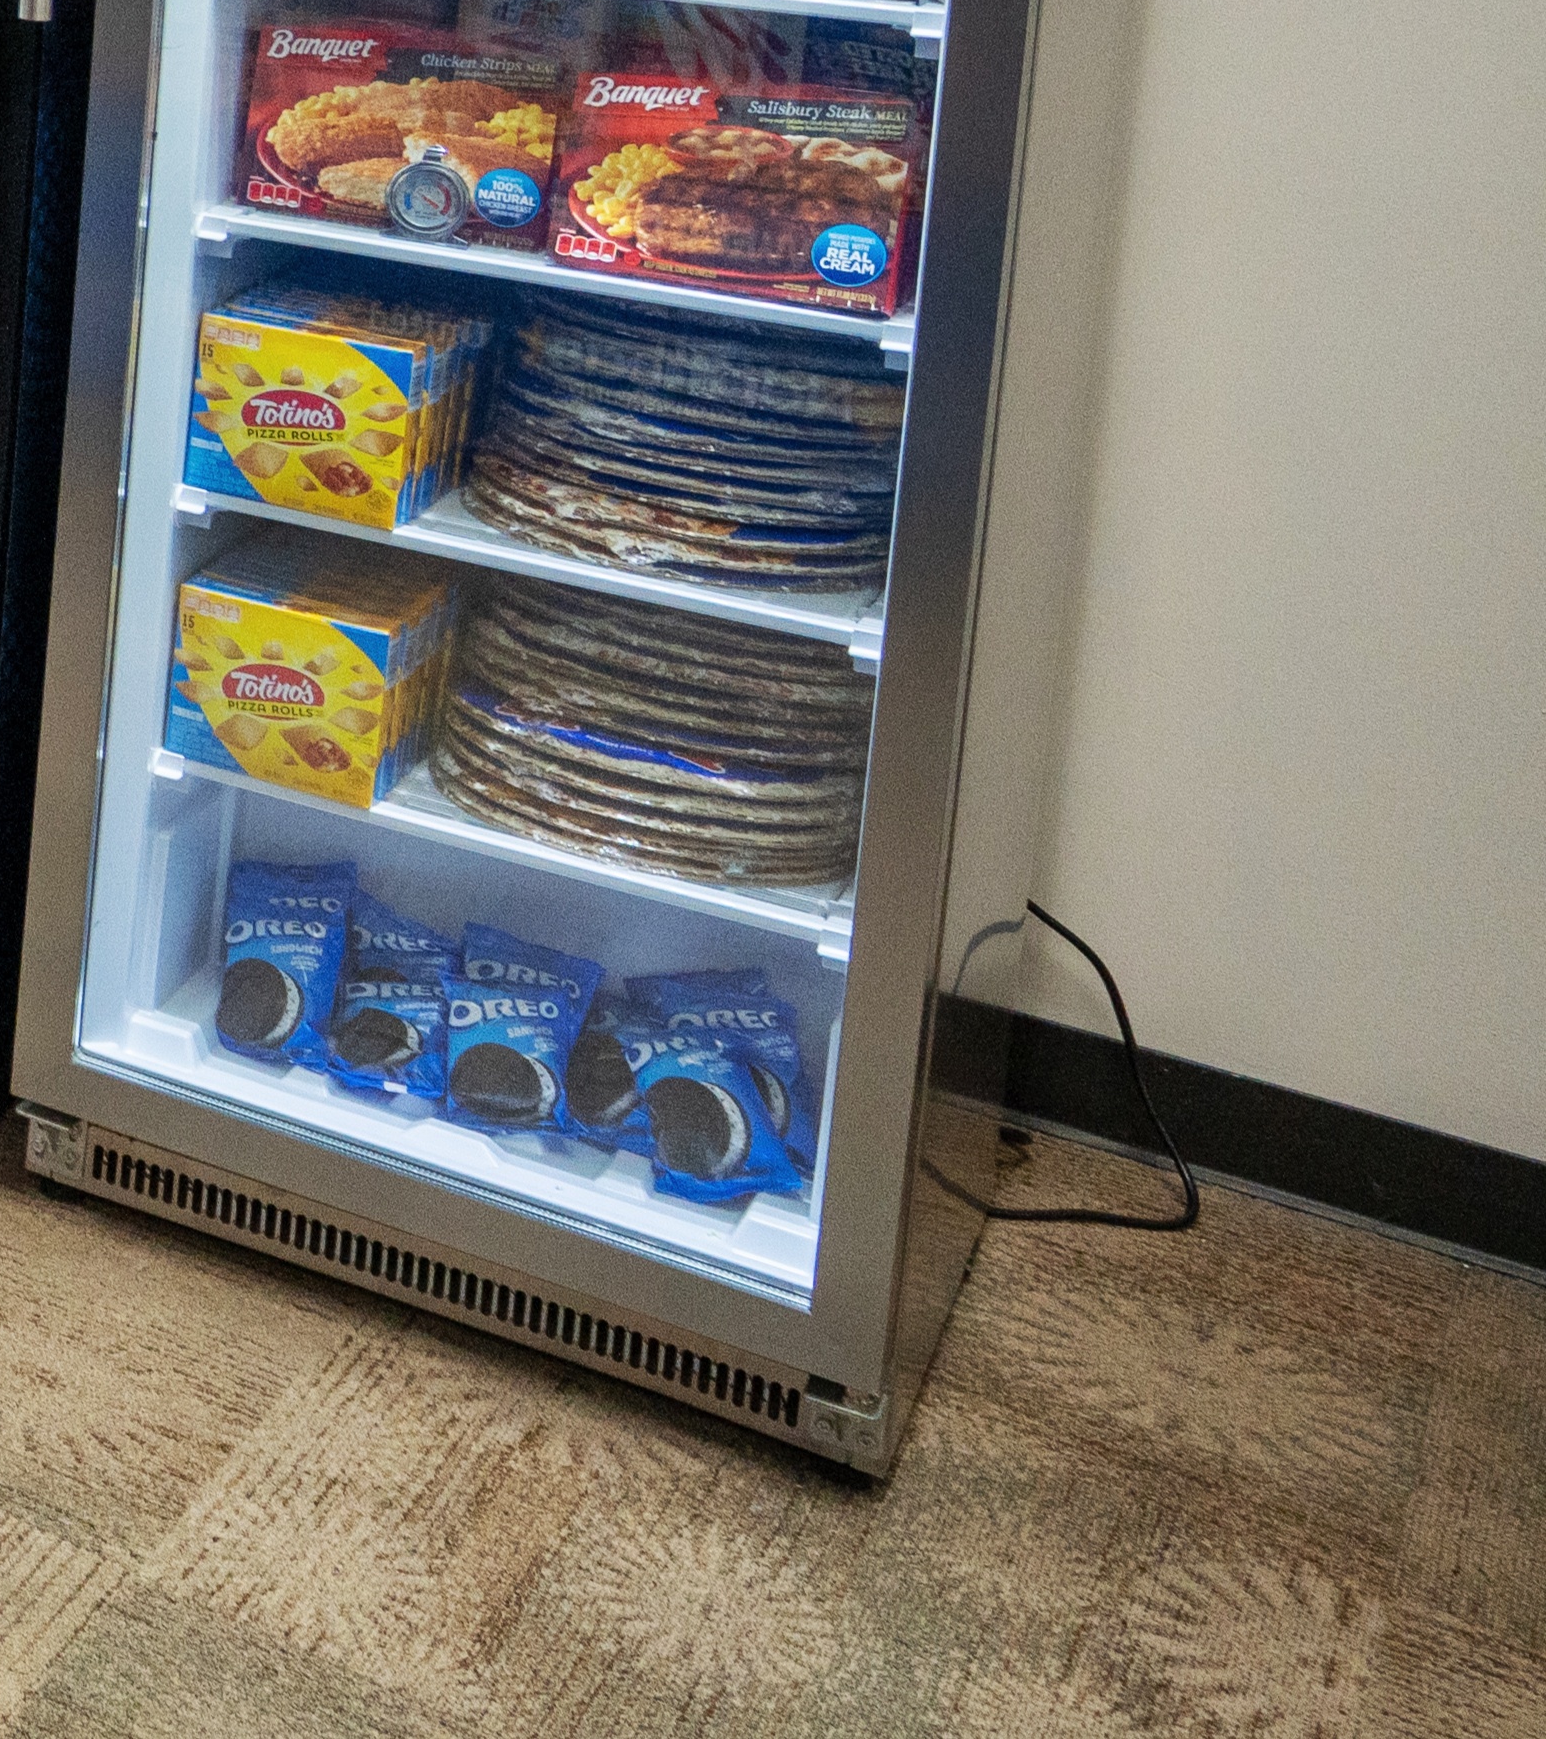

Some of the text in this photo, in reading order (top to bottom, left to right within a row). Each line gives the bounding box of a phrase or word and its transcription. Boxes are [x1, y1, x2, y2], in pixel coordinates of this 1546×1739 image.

[267, 29, 380, 62] Banquet
[421, 53, 477, 70] Chicken
[480, 56, 523, 73] Strips
[583, 76, 711, 111] Banquet
[747, 100, 907, 122] Salisbury Steak MEAL
[492, 180, 524, 194] 100%
[478, 189, 536, 207] NATURAL
[478, 200, 506, 209] CHICKEN
[826, 246, 873, 264] REAL
[819, 256, 876, 276] CREAM
[202, 342, 214, 358] 15
[250, 398, 336, 429] Totino's
[247, 428, 334, 442] PIZZA ROLLS
[182, 614, 195, 629] 15
[229, 670, 315, 704] Totino's
[227, 700, 314, 718] PIZZA ROLLS
[225, 919, 327, 944] OREO
[270, 944, 323, 956] SANDWICH
[448, 999, 560, 1028] OREO
